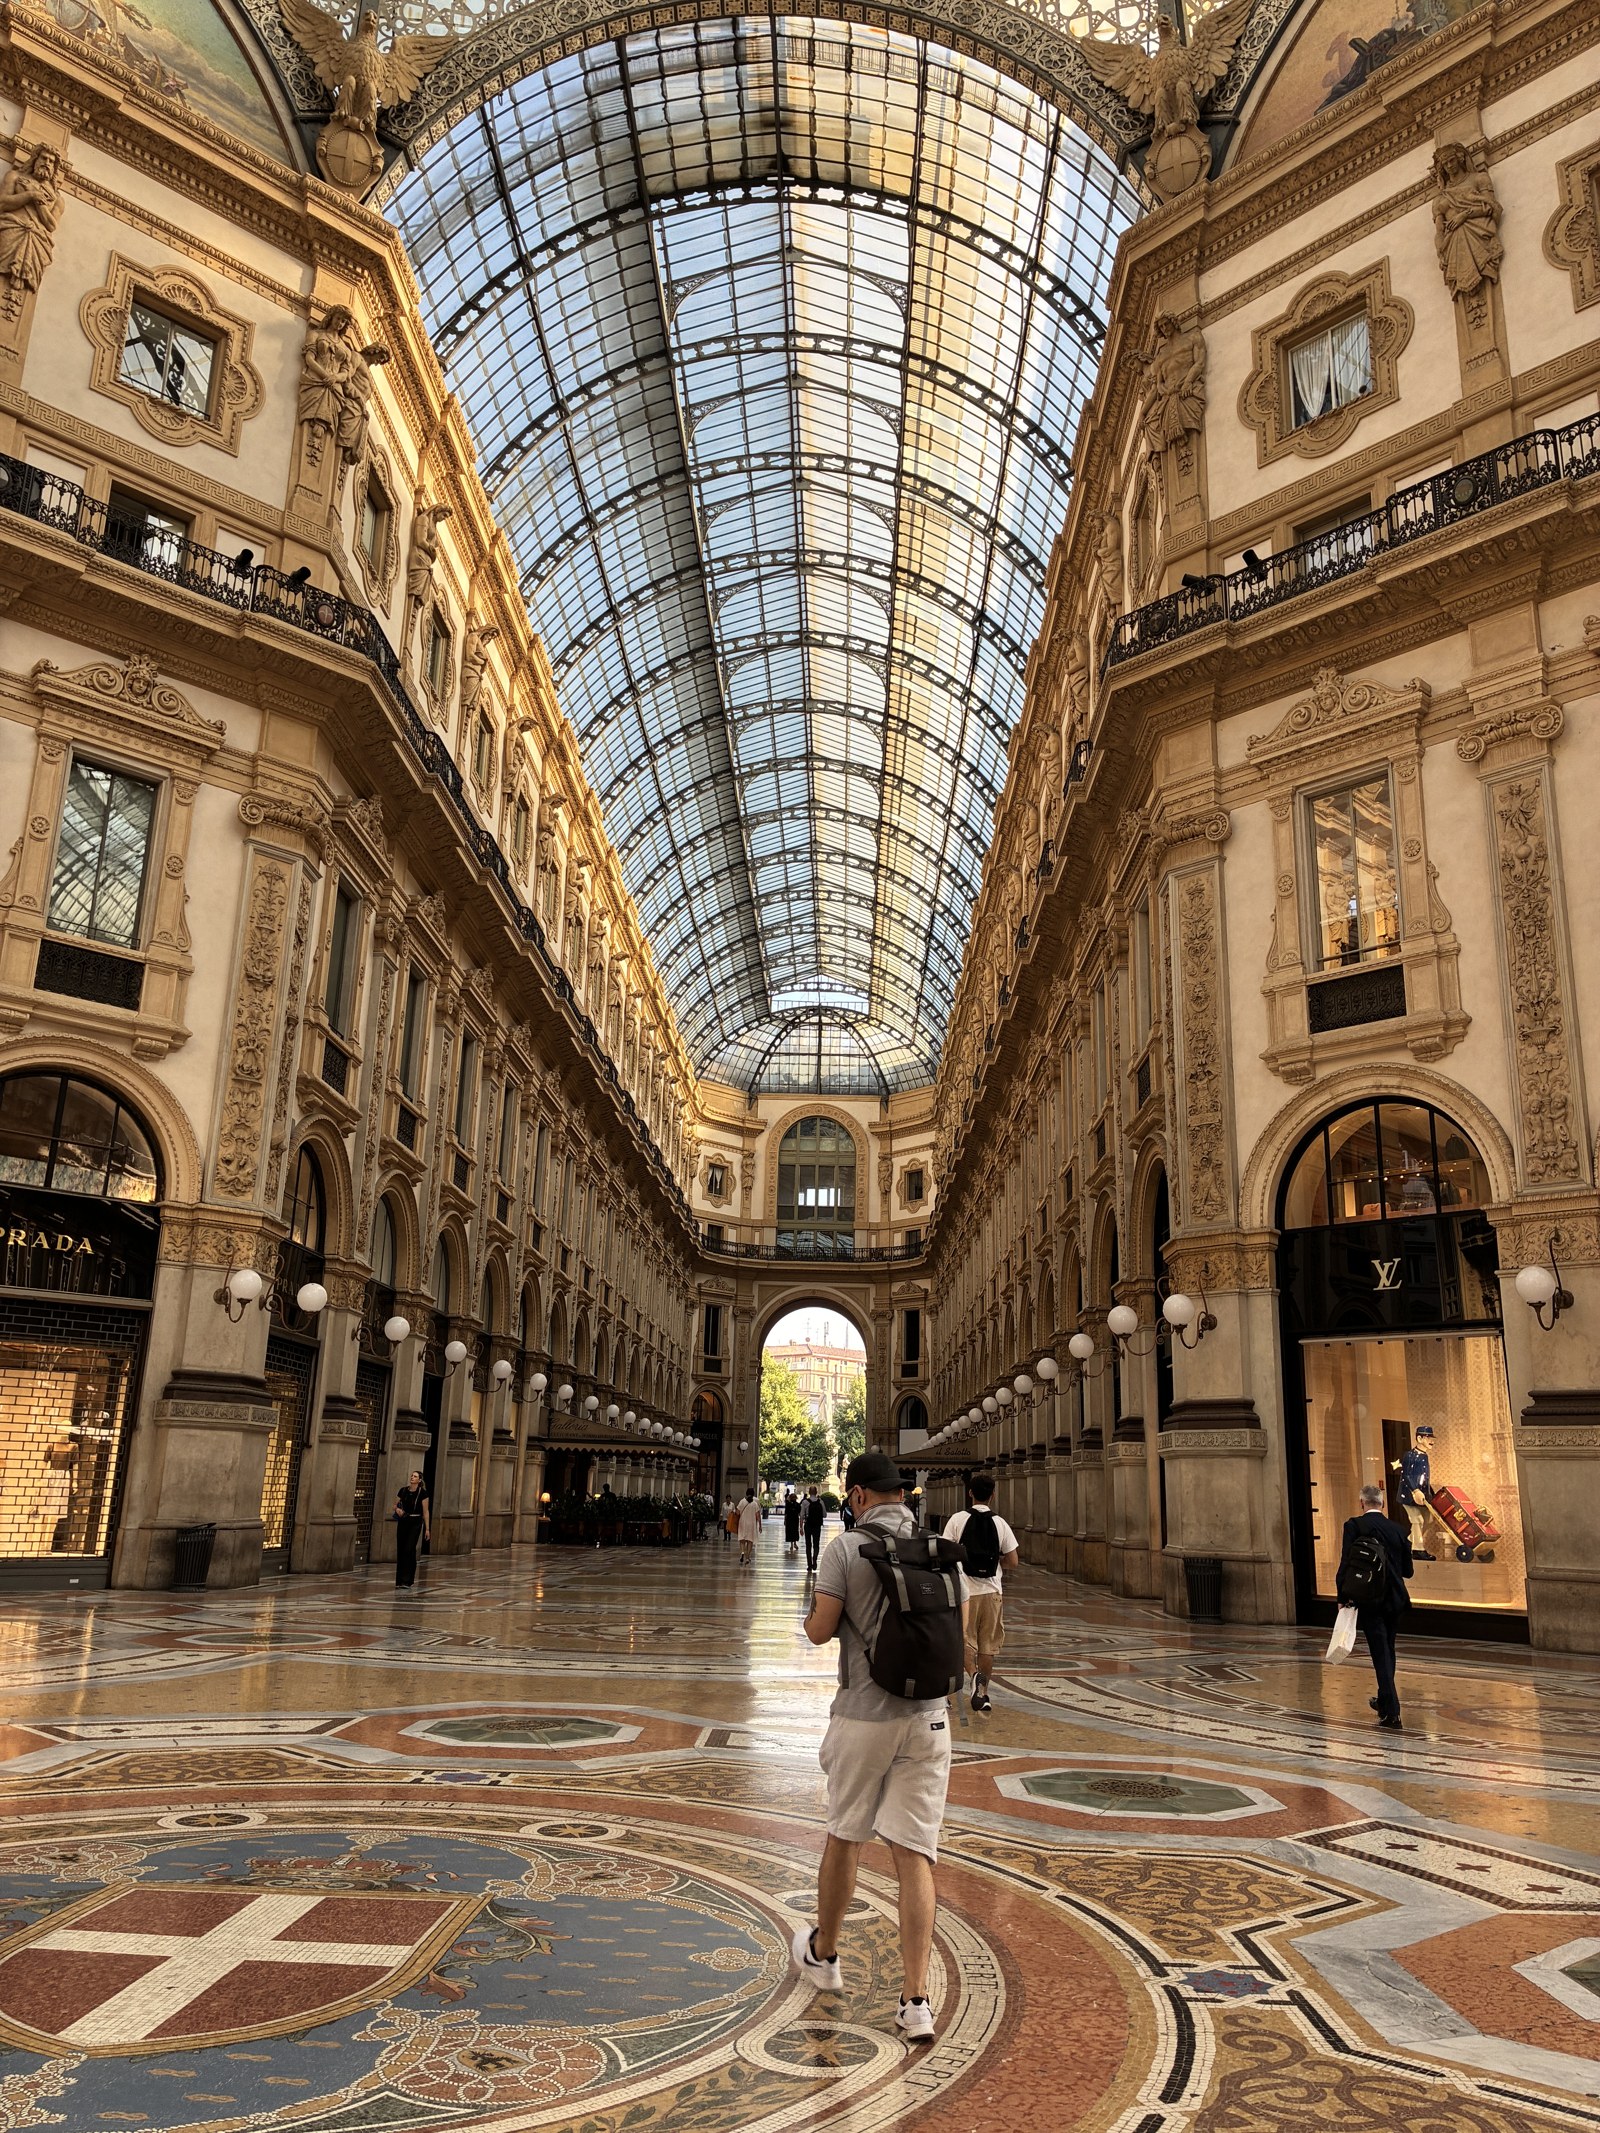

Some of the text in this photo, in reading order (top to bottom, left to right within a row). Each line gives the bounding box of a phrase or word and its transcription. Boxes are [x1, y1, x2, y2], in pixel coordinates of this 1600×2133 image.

[275, 1277, 300, 1297] PRA
[944, 1446, 971, 1456] Salotto
[959, 1954, 999, 1990] FERT
[904, 2045, 977, 2093] FERT
